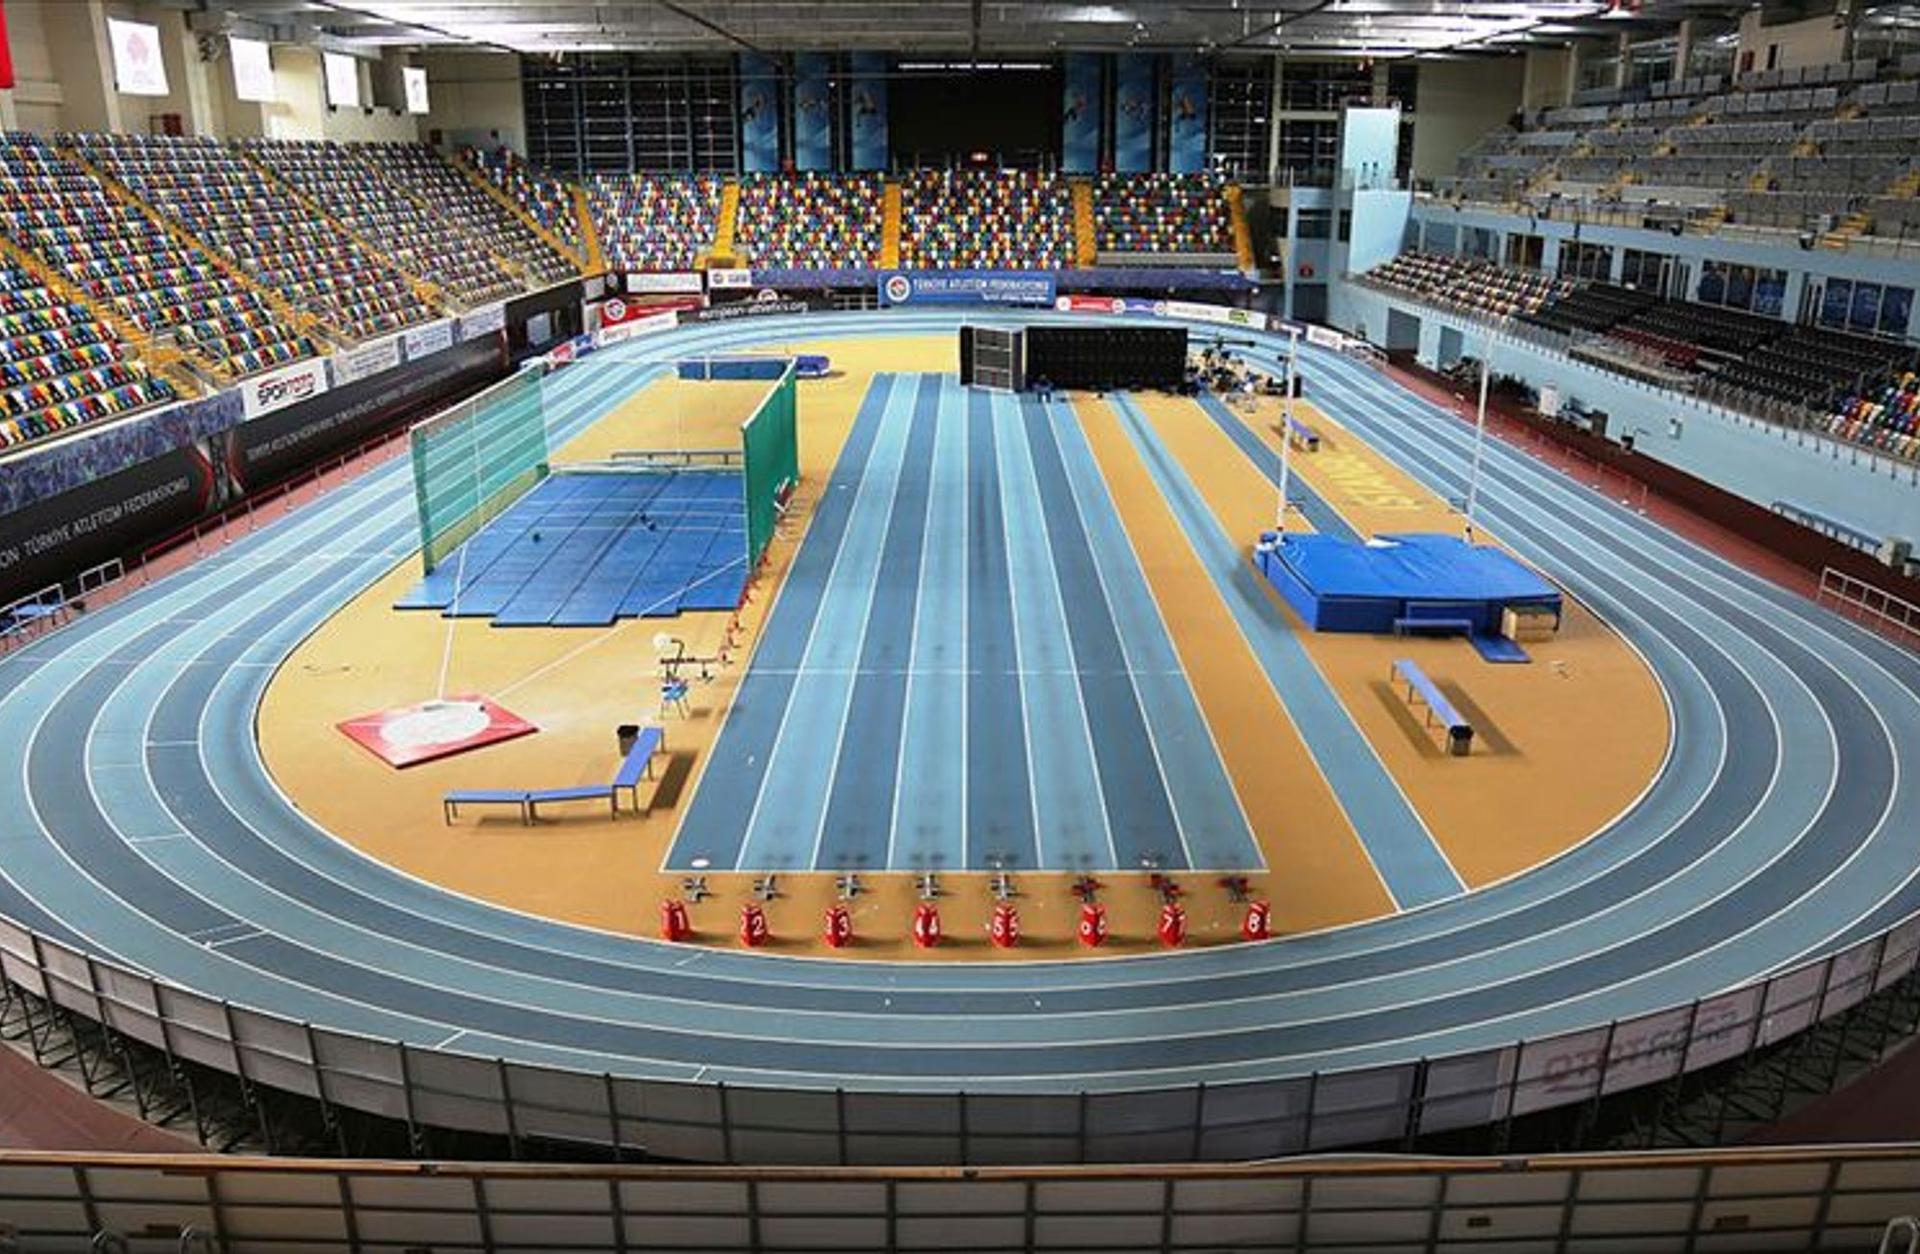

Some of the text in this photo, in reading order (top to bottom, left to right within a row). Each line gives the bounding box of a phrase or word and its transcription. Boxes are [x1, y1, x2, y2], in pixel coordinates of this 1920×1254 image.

[753, 915, 763, 936] 2
[838, 914, 848, 937] 3
[1248, 912, 1260, 933] 8
